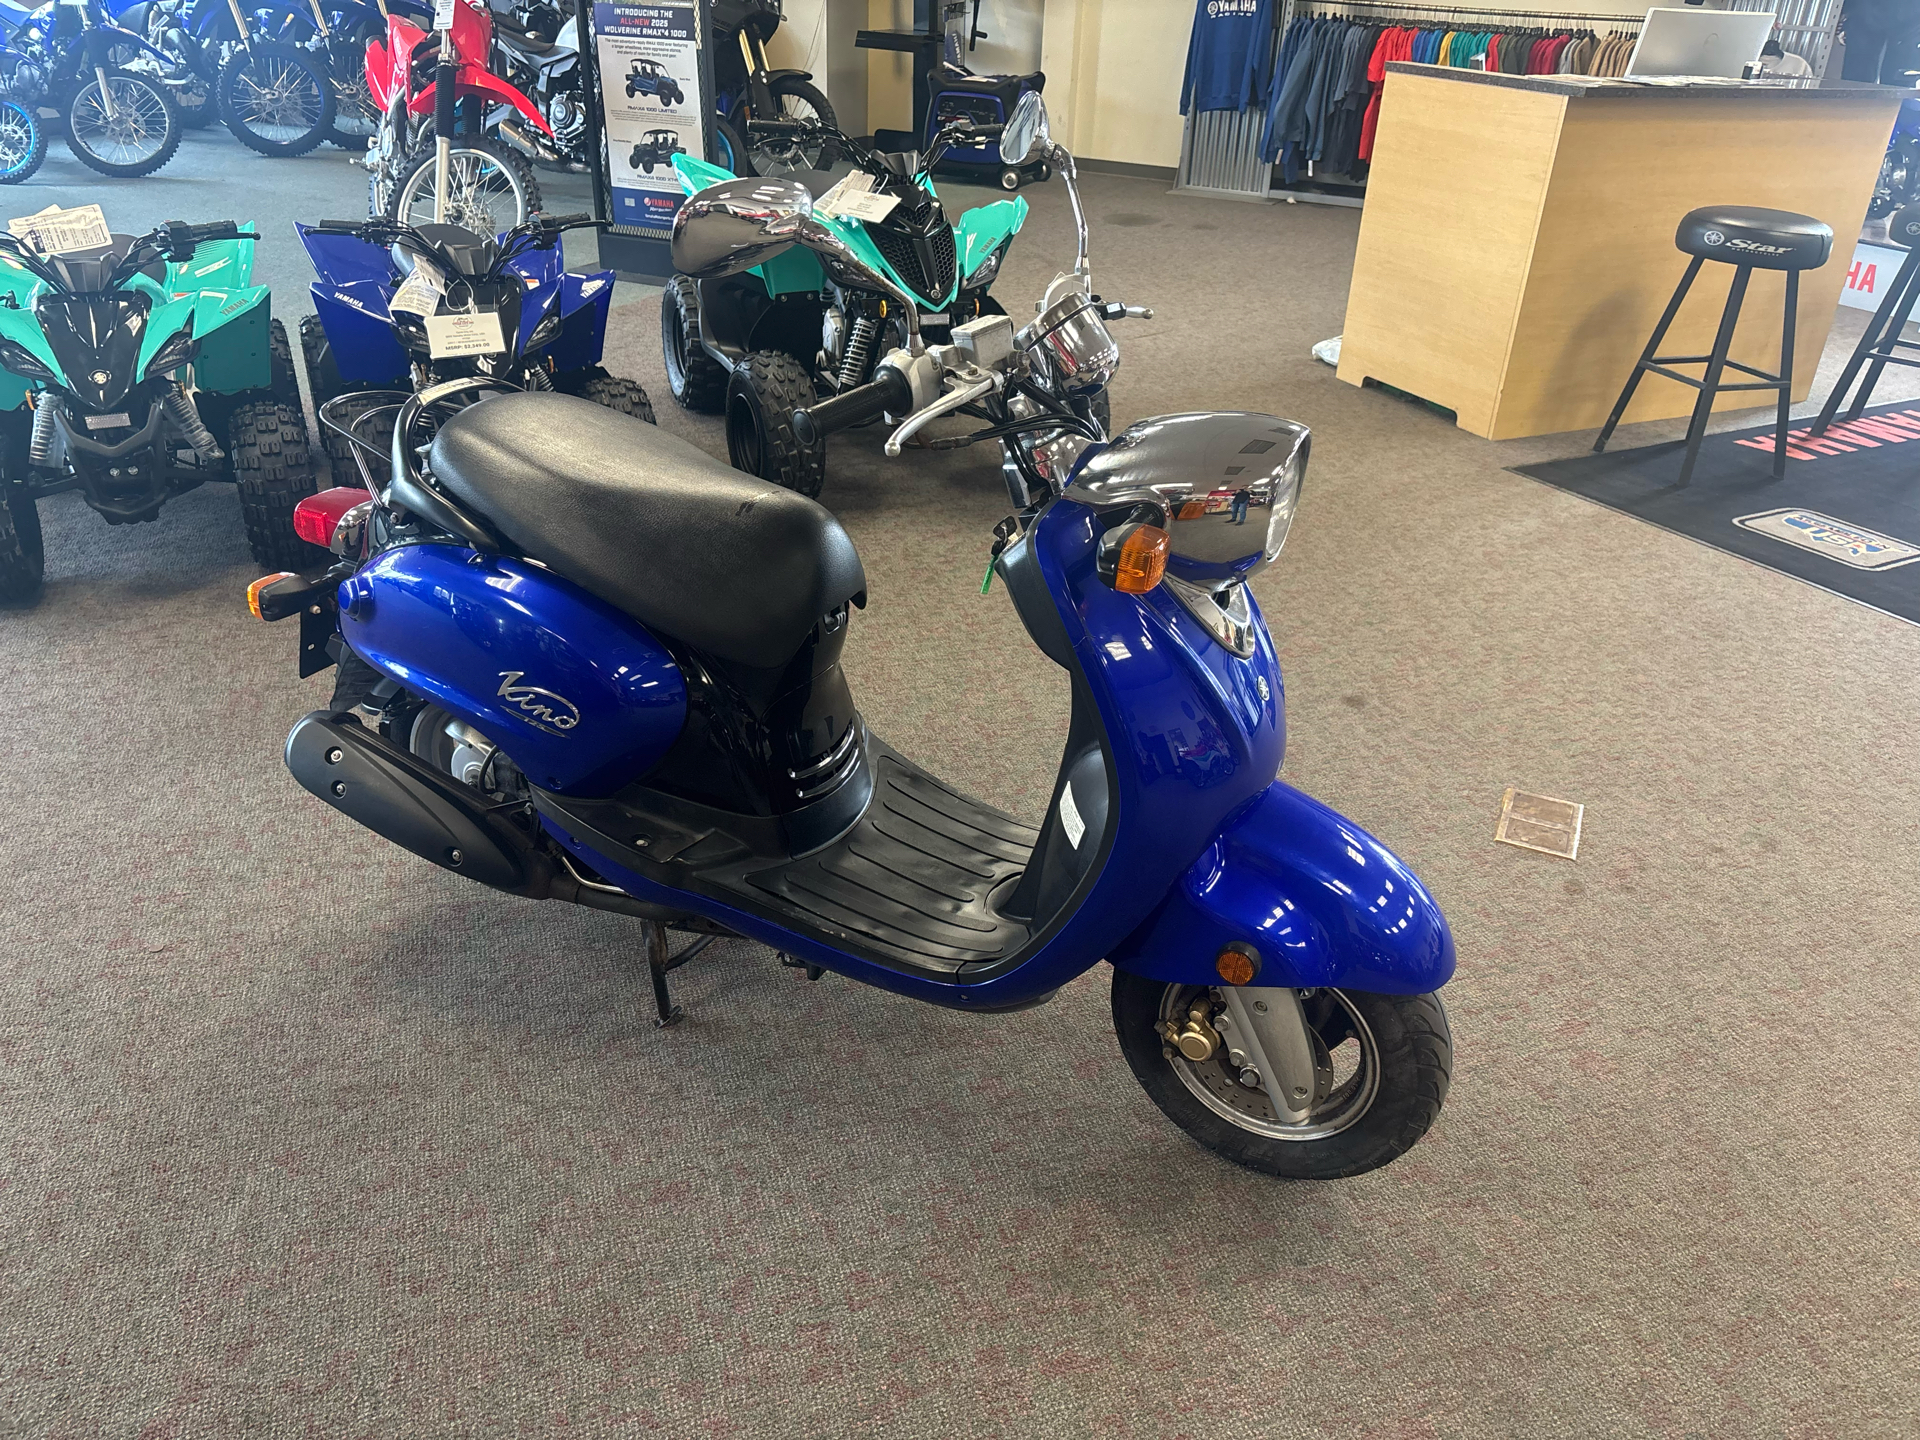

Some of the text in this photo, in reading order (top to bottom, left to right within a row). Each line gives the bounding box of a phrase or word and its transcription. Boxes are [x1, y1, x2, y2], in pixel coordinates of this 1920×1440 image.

[614, 8, 674, 18] INTRODUCING THE
[620, 18, 668, 27] ALL-NEW 2025
[604, 26, 641, 35] WOLVERINE
[670, 30, 687, 38] 1000
[650, 198, 674, 208] YAMAHA
[1725, 238, 1793, 254] Star
[220, 298, 249, 316] YAMAHA
[334, 292, 364, 308] YAMAHA
[1732, 409, 1920, 461] AMAHA
[497, 671, 580, 730] Vino
